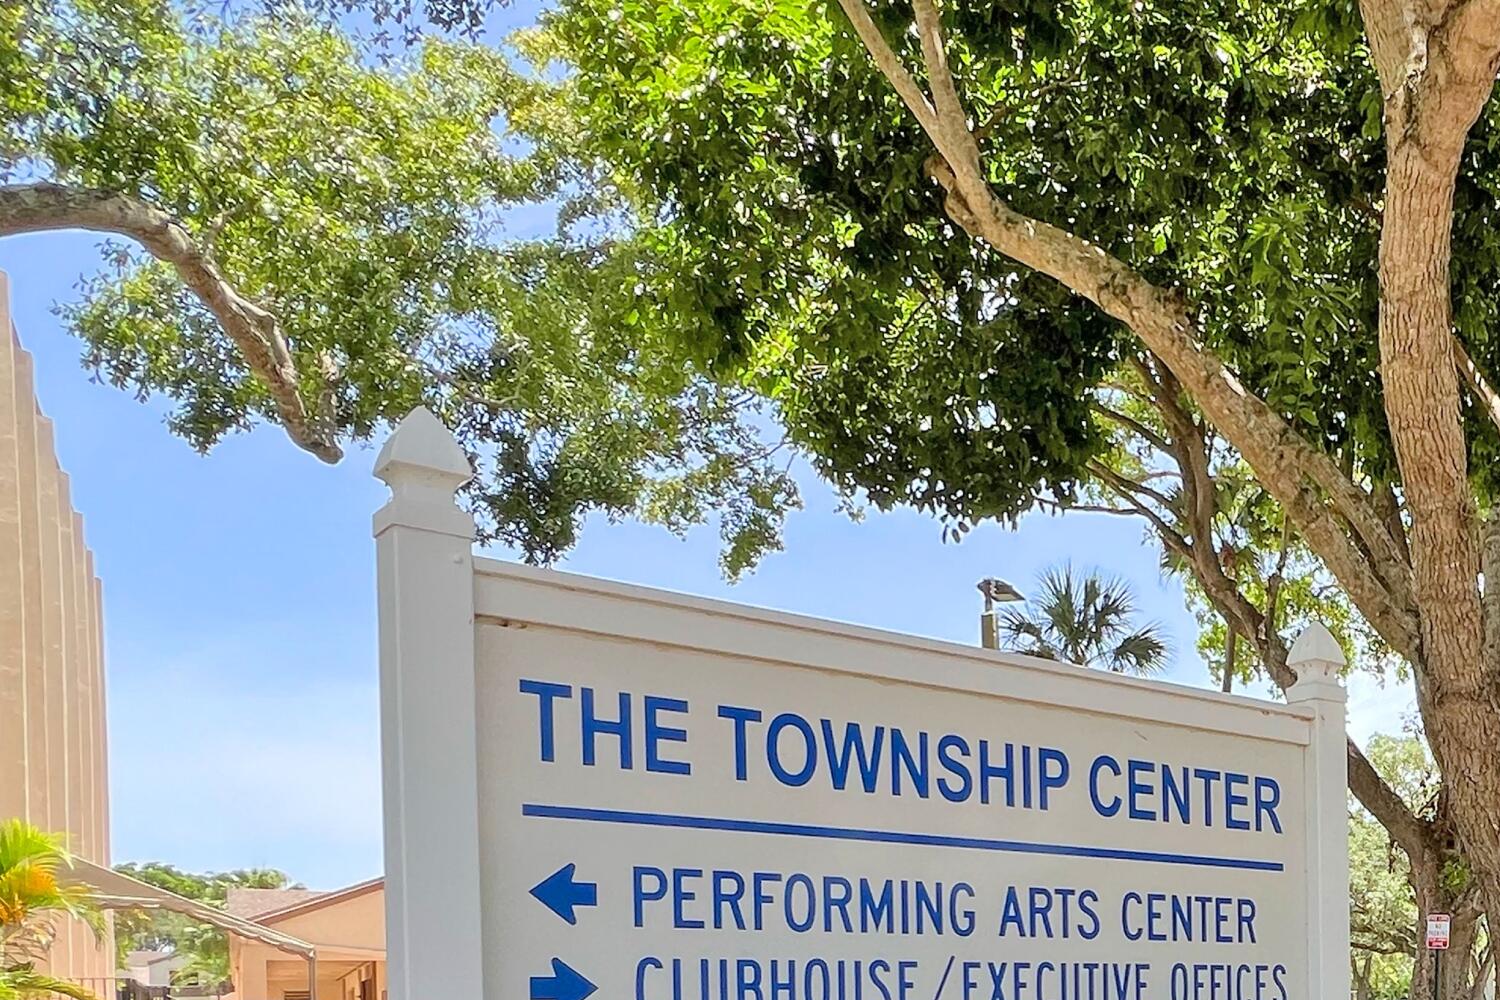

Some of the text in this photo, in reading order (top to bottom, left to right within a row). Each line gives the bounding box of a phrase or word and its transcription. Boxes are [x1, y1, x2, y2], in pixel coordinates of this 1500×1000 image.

[519, 679, 1284, 834] THE TOWNSHIP CENTER
[632, 865, 1258, 944] PERFORMING ARTS CENTER
